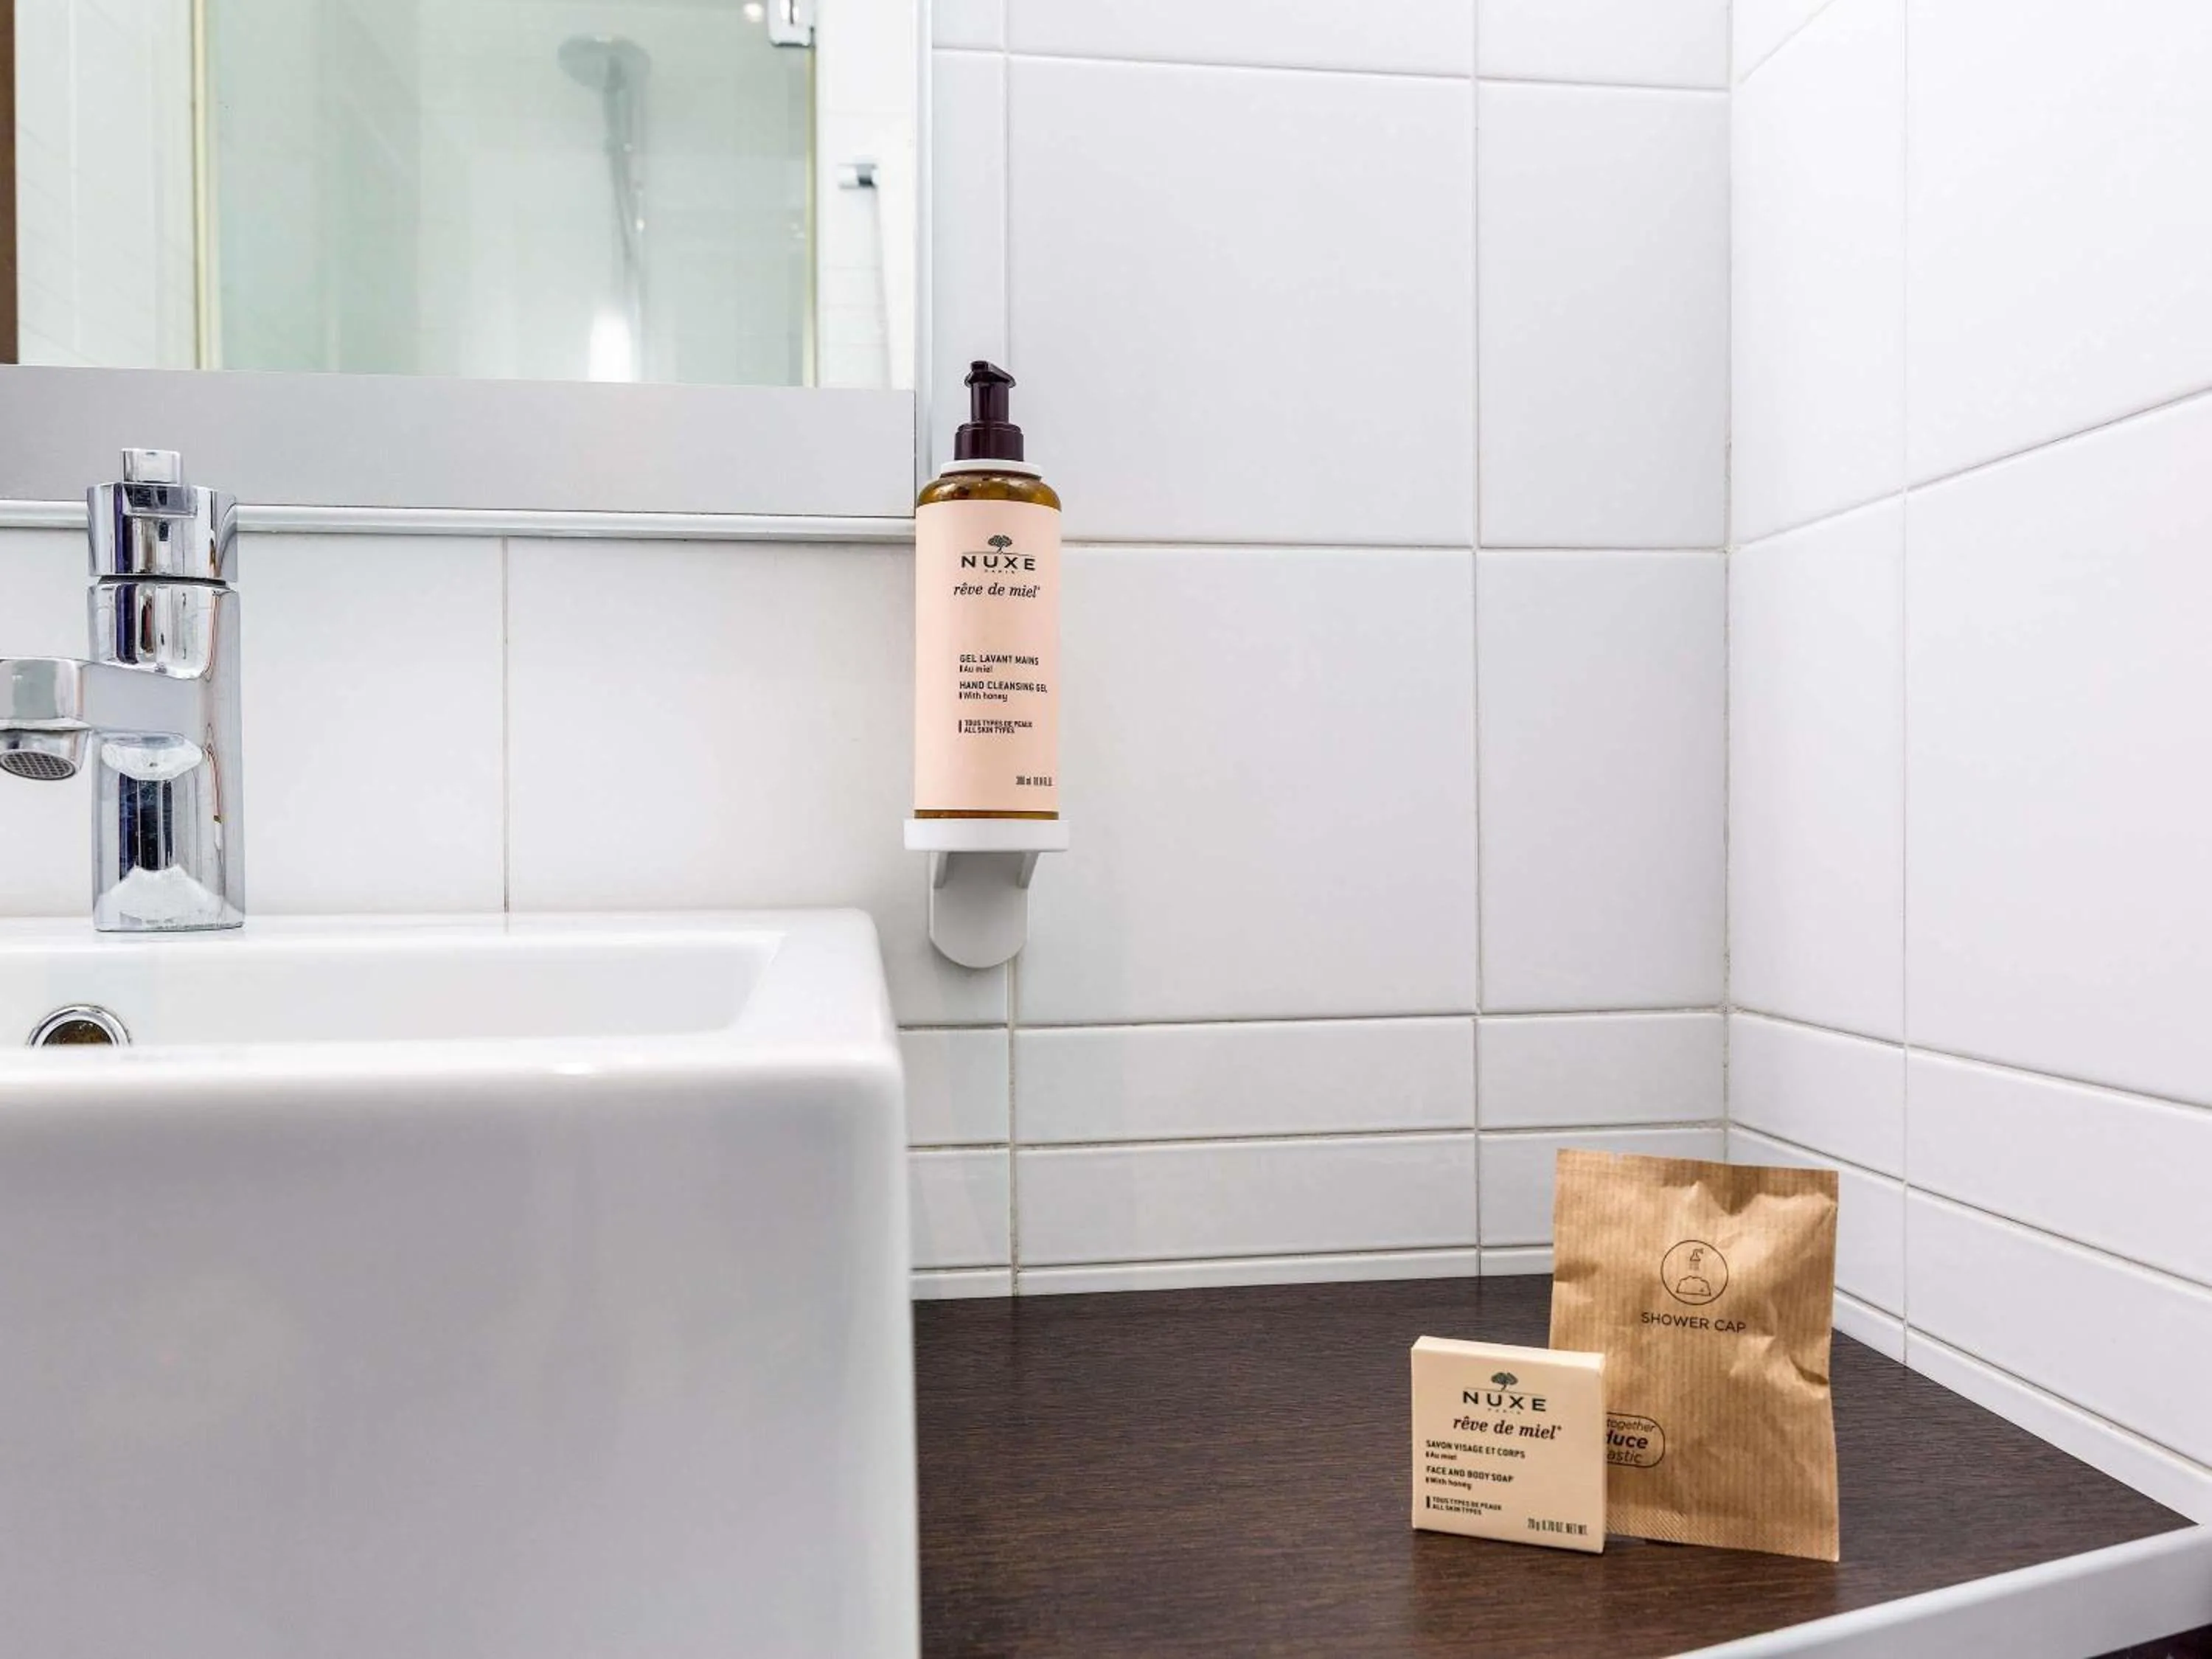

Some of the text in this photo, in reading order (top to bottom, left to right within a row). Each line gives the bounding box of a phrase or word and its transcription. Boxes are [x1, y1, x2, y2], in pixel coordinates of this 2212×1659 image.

[961, 555, 1036, 571] NUXE
[953, 582, 983, 596] rêve
[987, 582, 1005, 596] de
[959, 654, 1039, 666] GEL LAVANT MAINS
[975, 665, 993, 673] miel
[959, 681, 1048, 693] HAND CLEANSING GEL
[983, 692, 1008, 702] honey
[1641, 1312, 1747, 1333] SHOWER CAP
[1463, 1391, 1546, 1412] NUXE
[1453, 1415, 1489, 1433] rêve
[1493, 1419, 1514, 1435] de
[1426, 1439, 1526, 1459] SAVON VISAGE ET CORPS
[1426, 1465, 1514, 1483] FACE AND BODY SOAP
[1448, 1478, 1472, 1491] honey
